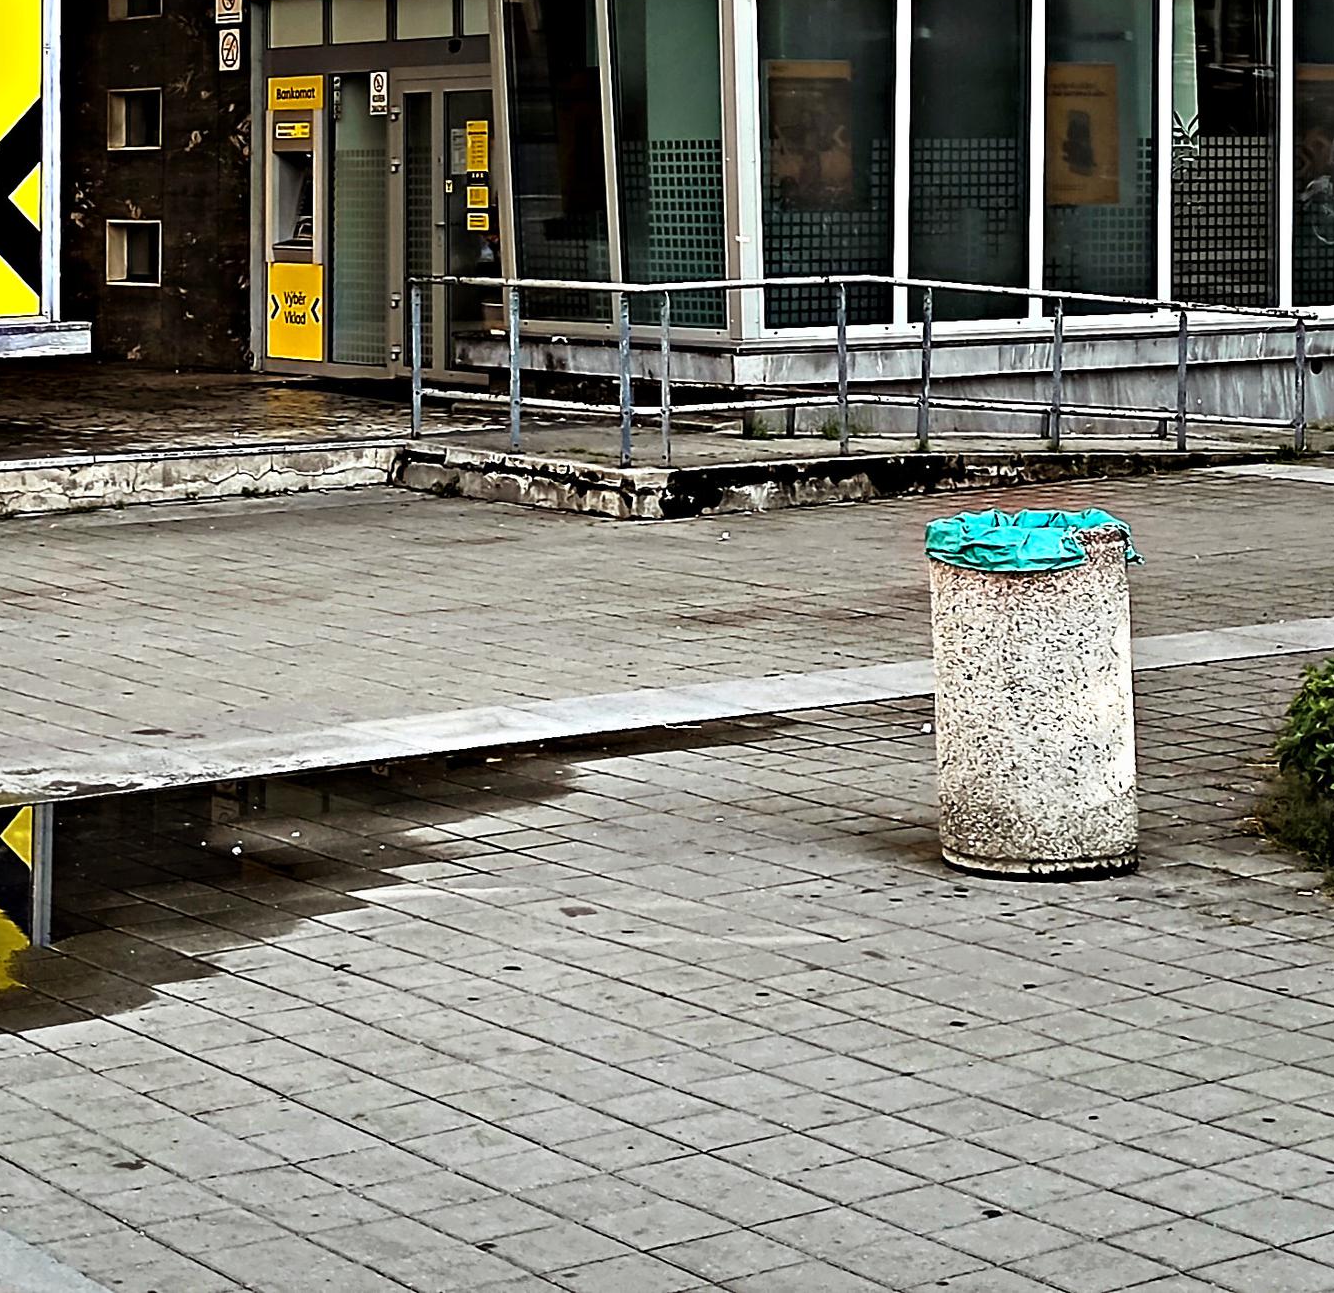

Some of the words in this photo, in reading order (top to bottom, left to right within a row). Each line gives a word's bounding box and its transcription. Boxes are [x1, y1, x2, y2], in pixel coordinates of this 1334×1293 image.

[276, 87, 316, 100] Bankomat
[283, 291, 307, 308] Výběr
[283, 311, 306, 325] Vklad
